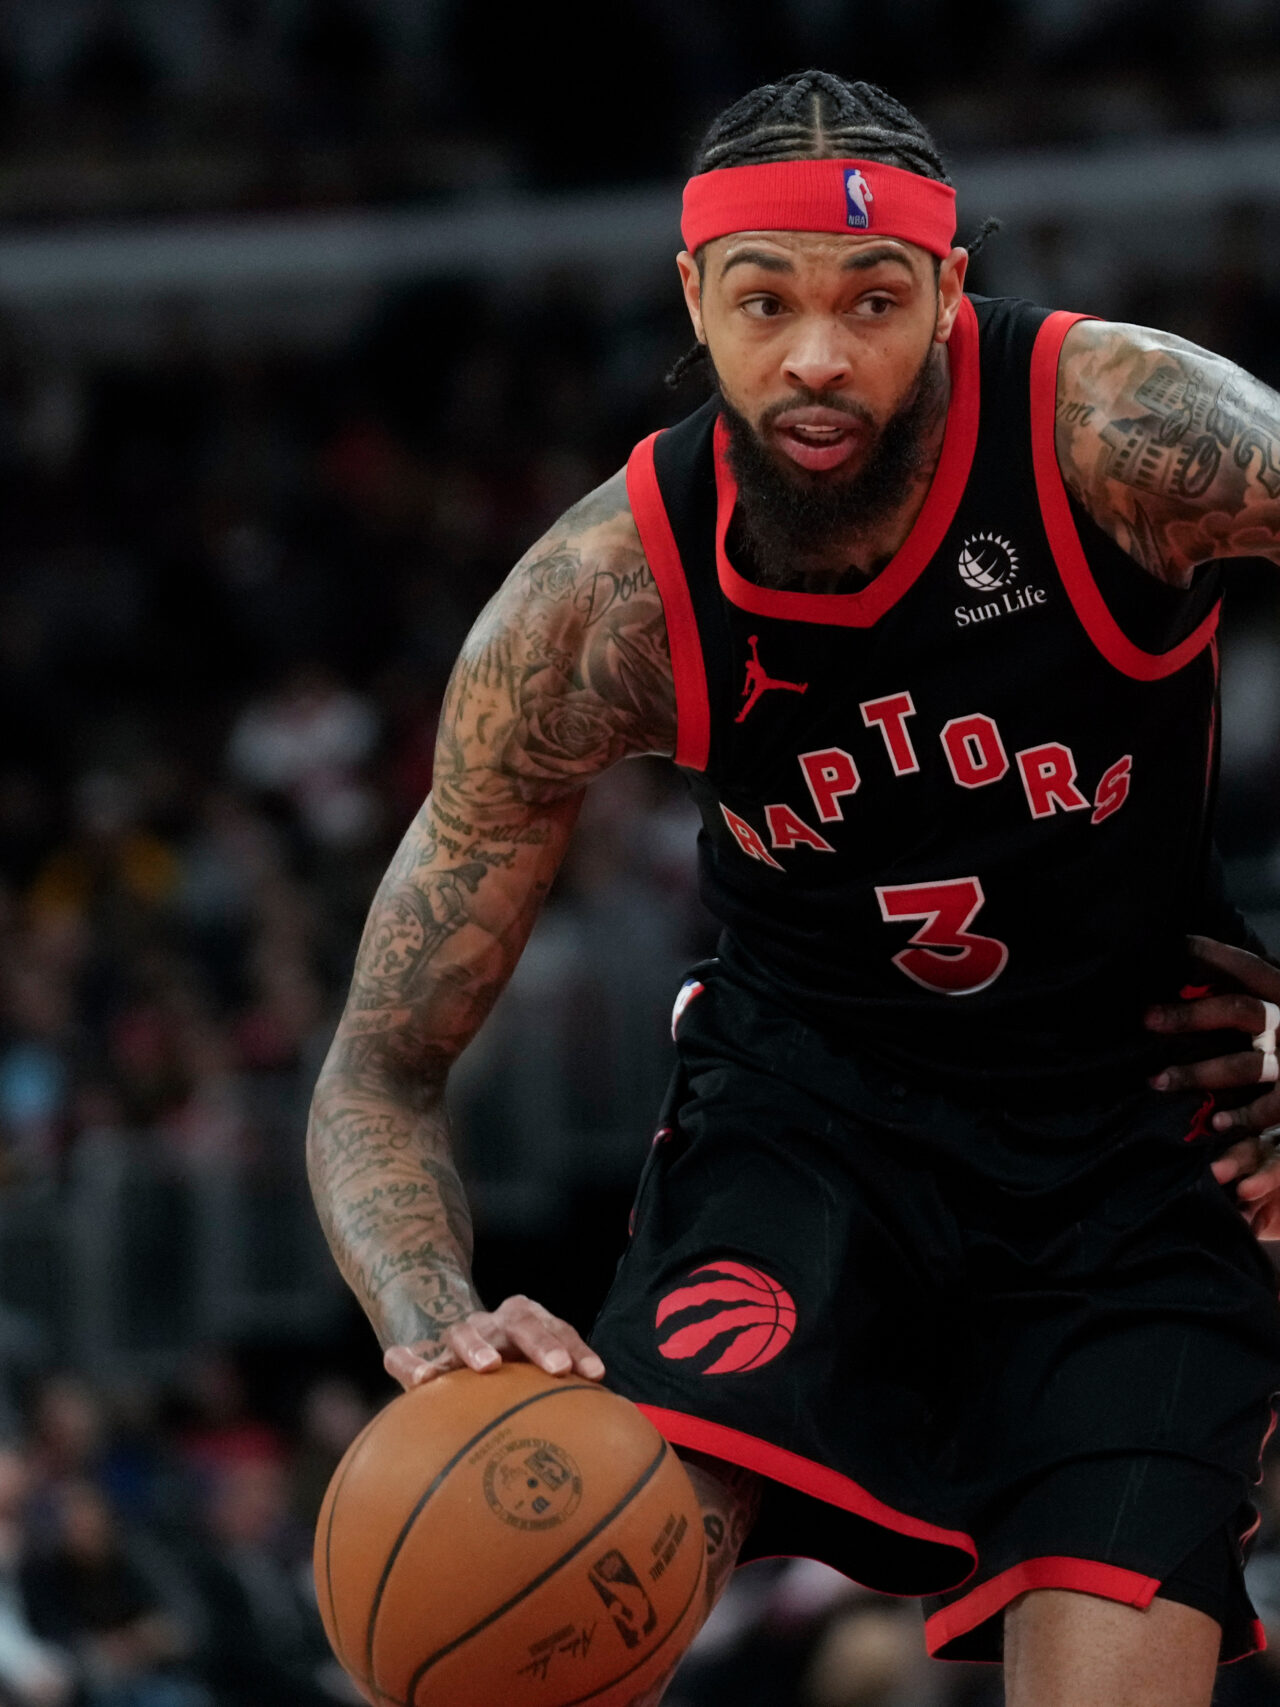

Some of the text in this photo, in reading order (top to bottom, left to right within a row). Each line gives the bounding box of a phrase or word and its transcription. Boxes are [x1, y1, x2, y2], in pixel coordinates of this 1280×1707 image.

[848, 214, 866, 226] NBA
[954, 585, 1047, 627] Sun Life
[718, 690, 1133, 873] RAPTORS
[873, 876, 1009, 996] 3
